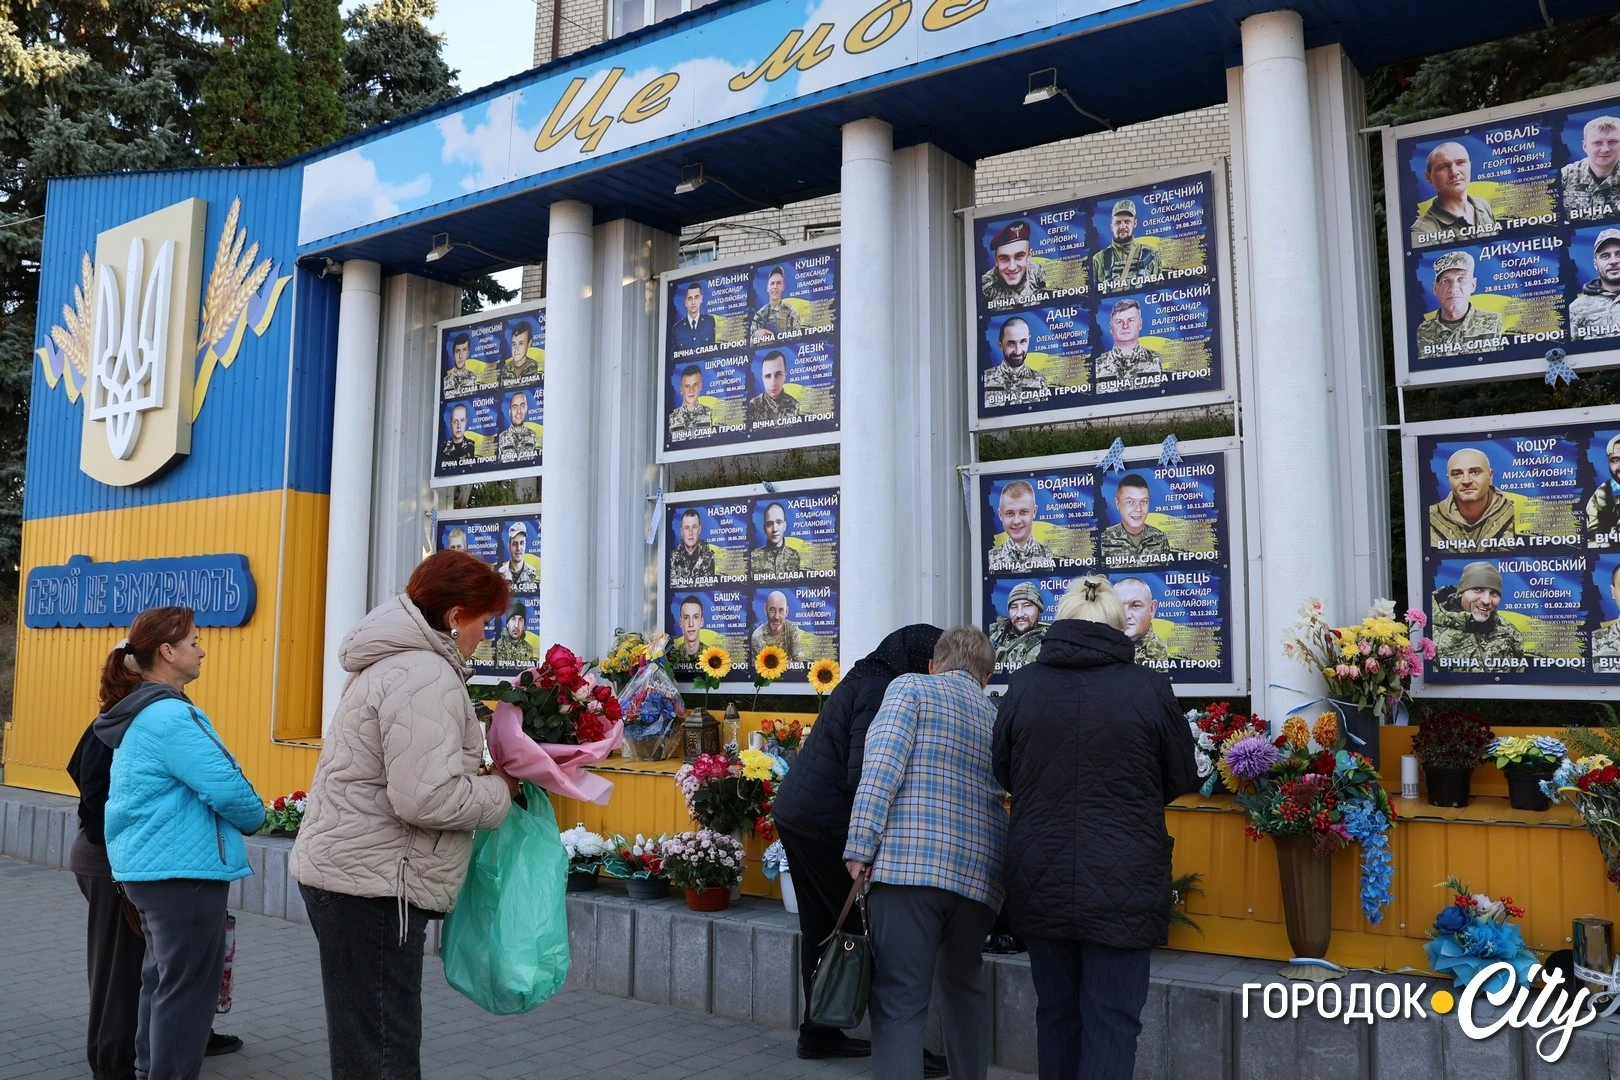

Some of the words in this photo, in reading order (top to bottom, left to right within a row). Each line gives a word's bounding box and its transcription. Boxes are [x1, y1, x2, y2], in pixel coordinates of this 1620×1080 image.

[534, 68, 680, 153] Це
[1485, 125, 1540, 144] КОВАЛЬ
[1492, 142, 1535, 156] МАКСИМ
[1483, 152, 1545, 169] ГЕОРГІЙОВИЧ
[1478, 168, 1512, 180] 05.03.1988
[1517, 162, 1551, 173] 26.12.2022
[1143, 182, 1204, 206] СЕРДЕЧНИЙ
[1151, 199, 1195, 215] ОЛЕКСАНДР
[1570, 203, 1613, 219] ВІЧНА
[1040, 210, 1076, 225] НЕСТЕР
[1143, 209, 1204, 227] ОЛЕКСАНДРОВИЧ
[1048, 225, 1069, 235] ЄВГЕН
[1418, 228, 1455, 244] ВІЧНА
[1460, 222, 1502, 236] СЛАВА
[1507, 213, 1557, 229] ГЕРОЮ!
[1039, 232, 1078, 246] ЮРІЙОВИЧ
[1479, 236, 1563, 261] ДИКУНЕЦЬ
[795, 256, 830, 270] КУШНІР
[1501, 256, 1540, 268] БОГДАН
[708, 272, 749, 288] МЕЛЬНИК
[794, 268, 829, 280] ОЛЕКСАНДР
[1097, 280, 1127, 292] ВІЧНА
[1131, 273, 1165, 285] СЛАВА
[1168, 265, 1207, 279] ГЕРОЮ!
[1493, 267, 1549, 281] ФЕОФАНОВИЧ
[797, 278, 826, 288] ІВАНОВИЧ
[1485, 283, 1518, 292] 28.01.1971
[1525, 278, 1559, 288] 16.01.2023
[712, 285, 743, 297] ОЛЕКСАНДР
[988, 297, 1015, 310] ВІЧНА
[1019, 291, 1048, 303] СЛАВА
[1052, 285, 1088, 298] ГЕРОЮ!
[1145, 283, 1211, 305] СЕЛЬСЬКИЙ
[1046, 308, 1077, 322] ДАЦЬ
[1156, 301, 1201, 315] ОЛЕКСАНДР
[1151, 311, 1205, 326] ВАЛЕРІЙОВИЧ
[1049, 321, 1074, 331] ПАВЛО
[753, 334, 775, 344] ВІЧНА
[777, 330, 802, 340] СЛАВА
[805, 324, 833, 335] ГЕРОЮ!
[1036, 329, 1086, 343] ОЛЕКСАНДРОВИЧ
[674, 350, 694, 358] ВІЧНА
[696, 346, 718, 354] СЛАВА
[720, 340, 746, 350] ГЕРОЮ!
[798, 343, 824, 356] ДЕЗІК
[1424, 342, 1461, 355] ВІЧНА
[1467, 338, 1509, 349] СЛАВА
[1514, 331, 1564, 344] ГЕРОЮ!
[705, 355, 748, 370] ШКРОМИДА
[794, 355, 829, 365] ОЛЕКСАНДР
[790, 362, 833, 375] ОЛЕКСАНДРОВИЧ
[710, 377, 741, 387] СЕРГІЙОВИЧ
[1101, 379, 1130, 390] ВІЧНА
[1134, 374, 1168, 386] СЛАВА
[1172, 368, 1211, 382] ГЕРОЮ!
[989, 392, 1017, 403] ВІЧНА
[1020, 389, 1051, 400] СЛАВА
[1055, 383, 1091, 395] ГЕРОЮ!
[473, 398, 494, 407] ПОПИК
[752, 420, 774, 429] ВІЧНА
[777, 416, 802, 426] СЛАВА
[804, 412, 833, 423] ГЕРОЮ!
[672, 430, 692, 439] ВІЧНА
[694, 427, 716, 436] СЛАВА
[719, 424, 746, 433] ГЕРОЮ!
[1517, 438, 1556, 454] КОЦУР
[1513, 454, 1563, 467] МИХАЙЛО
[1155, 464, 1215, 480] ЯРОШЕНКО
[1502, 467, 1573, 479] МИХАЙЛОВИЧ
[1037, 473, 1094, 491] ВОДЯНИЙ
[1170, 481, 1198, 491] ВАДИМ
[1500, 482, 1535, 490] 09.02.1981
[1541, 480, 1577, 488] 24.01.2023
[788, 494, 838, 509] ХАЄЦЬКИЙ
[1053, 491, 1079, 500] РОМАН
[1165, 492, 1203, 502] ПЕТРОВИЧ
[708, 505, 747, 516] НАЗАРОВ
[1046, 501, 1086, 512] ВАДИМОВИЧ
[795, 510, 831, 518] ВЛАДИСЛАВ
[468, 523, 499, 533] ВЕРХОМІЙ
[710, 527, 743, 535] ВІКТОРОВИЧ
[794, 520, 832, 528] РУСЛАНОВИЧ
[1437, 538, 1476, 550] ВІЧНА
[1481, 537, 1525, 548] СЛАВА
[1529, 535, 1581, 546] ГЕРОЮ!
[993, 562, 1021, 571] ВІЧНА
[1024, 559, 1056, 569] СЛАВА
[1059, 557, 1096, 567] ГЕРОЮ!
[1105, 555, 1136, 565] ВІЧНА
[1139, 553, 1175, 563] СЛАВА
[1178, 551, 1218, 562] ГЕРОЮ!
[1498, 556, 1586, 573] КІСІЛЬОВСЬКИЙ
[673, 577, 693, 585] ВІЧНА
[754, 572, 776, 581] ВІЧНА
[778, 571, 804, 579] СЛАВА
[806, 569, 836, 578] ГЕРОЮ!
[1166, 573, 1210, 586] ШВЕЦЬ
[1530, 577, 1555, 586] ОЛЕГ
[29, 567, 80, 615] ГЕРОЇ
[84, 575, 108, 614] НЕ
[714, 592, 740, 602] БАШУК
[796, 587, 831, 598] РИЖИЙ
[1164, 588, 1212, 596] ОЛЕКСАНДР
[1514, 589, 1571, 599] ОЛЕКСІЙОВИЧ
[1159, 596, 1217, 607] МИКОЛАЙОВИЧ
[712, 613, 740, 621] ЮРІЙОВИЧ
[796, 610, 831, 618] МИХАЙЛОВИЧ
[1180, 659, 1220, 669] ГЕРОЮ!
[1440, 658, 1479, 668] ВІЧНА
[1484, 658, 1529, 668] СЛАВА
[1534, 657, 1586, 668] ГЕРОЮ!
